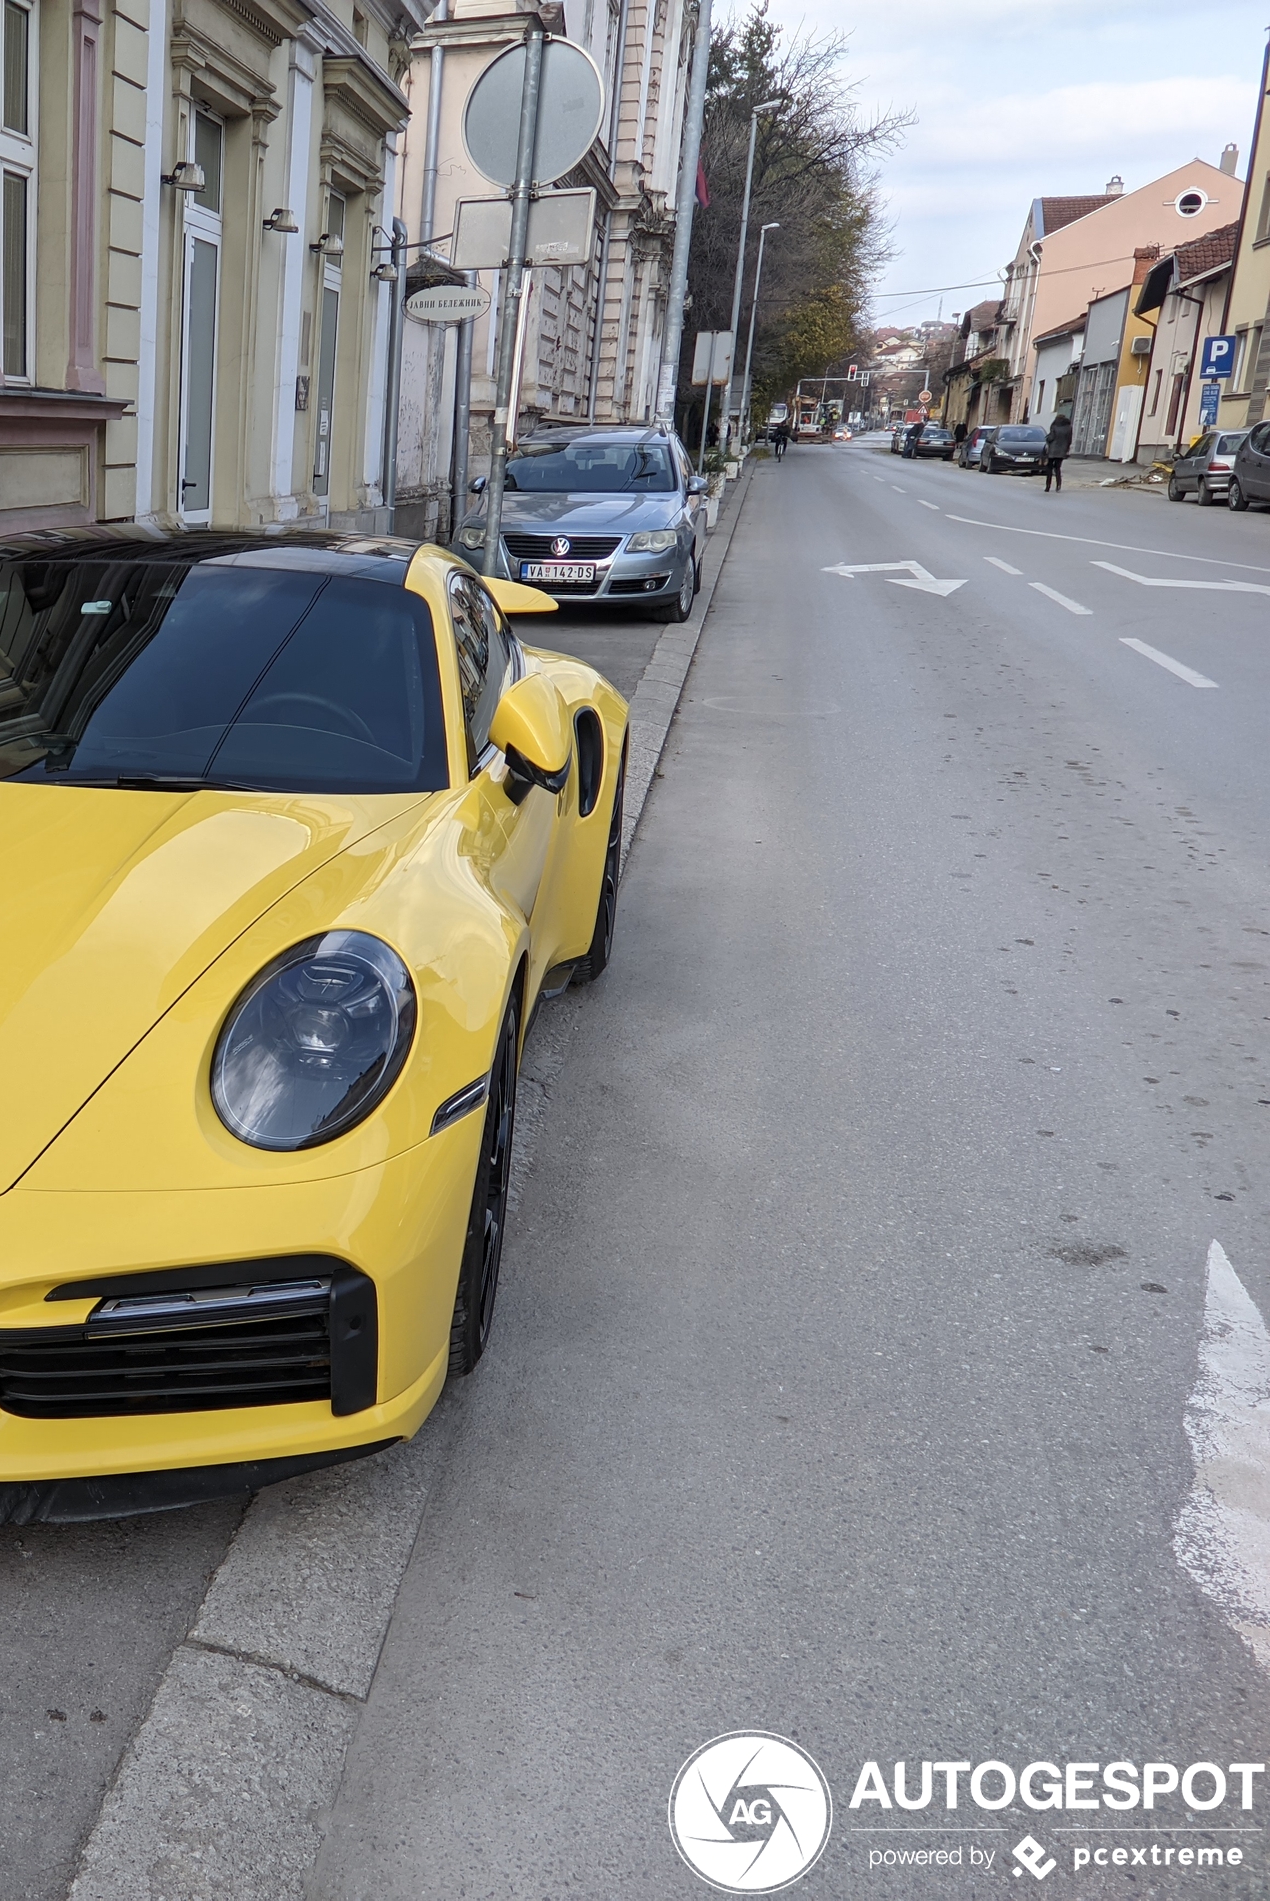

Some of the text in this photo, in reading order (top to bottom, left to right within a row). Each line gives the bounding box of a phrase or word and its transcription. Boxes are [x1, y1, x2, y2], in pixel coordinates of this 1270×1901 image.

[409, 298, 482, 309] ЈАВНИ БЕЛЕЖНИК
[1210, 340, 1229, 362] P
[530, 566, 543, 577] VA
